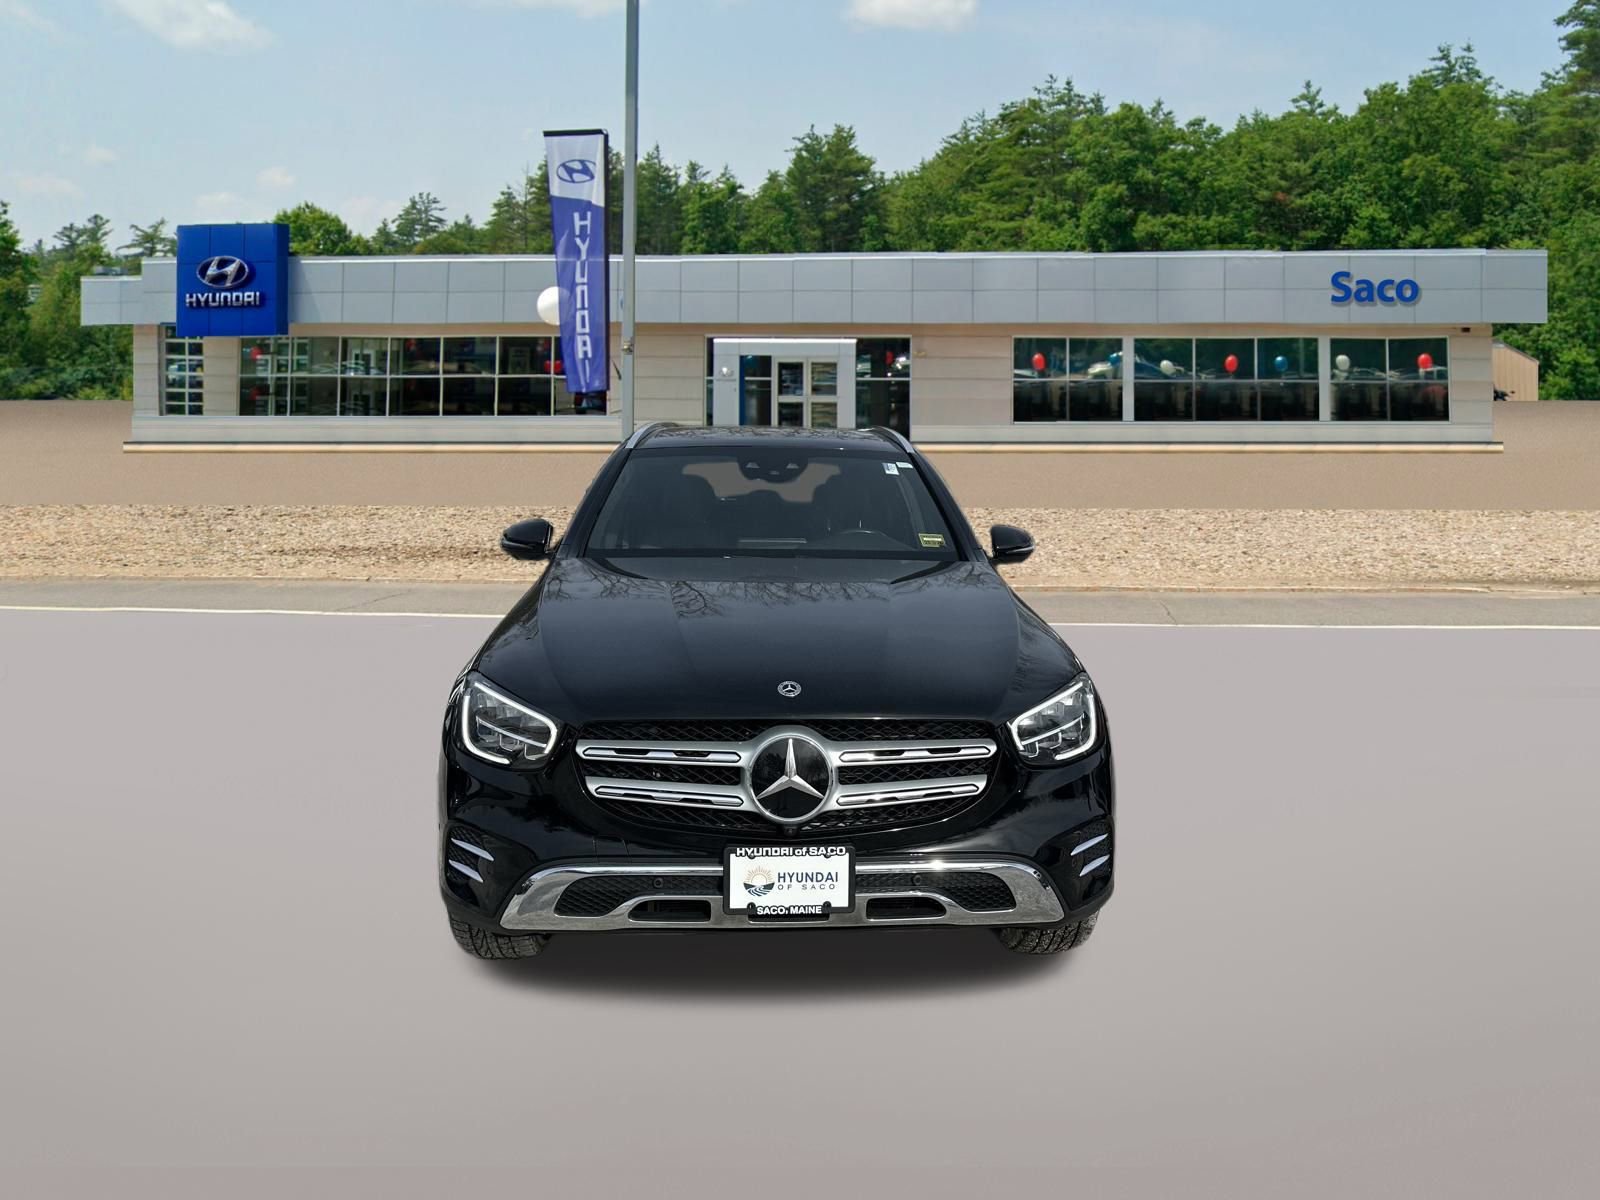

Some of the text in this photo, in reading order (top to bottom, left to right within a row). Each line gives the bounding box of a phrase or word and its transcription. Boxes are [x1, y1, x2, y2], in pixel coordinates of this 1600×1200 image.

[1331, 271, 1419, 302] Saco
[185, 291, 260, 307] HYUNDAI
[573, 211, 592, 383] HYUNDAI
[736, 846, 846, 856] HYUNDAI of SACO
[777, 872, 838, 883] HYUNDAI
[790, 906, 822, 914] MAINE
